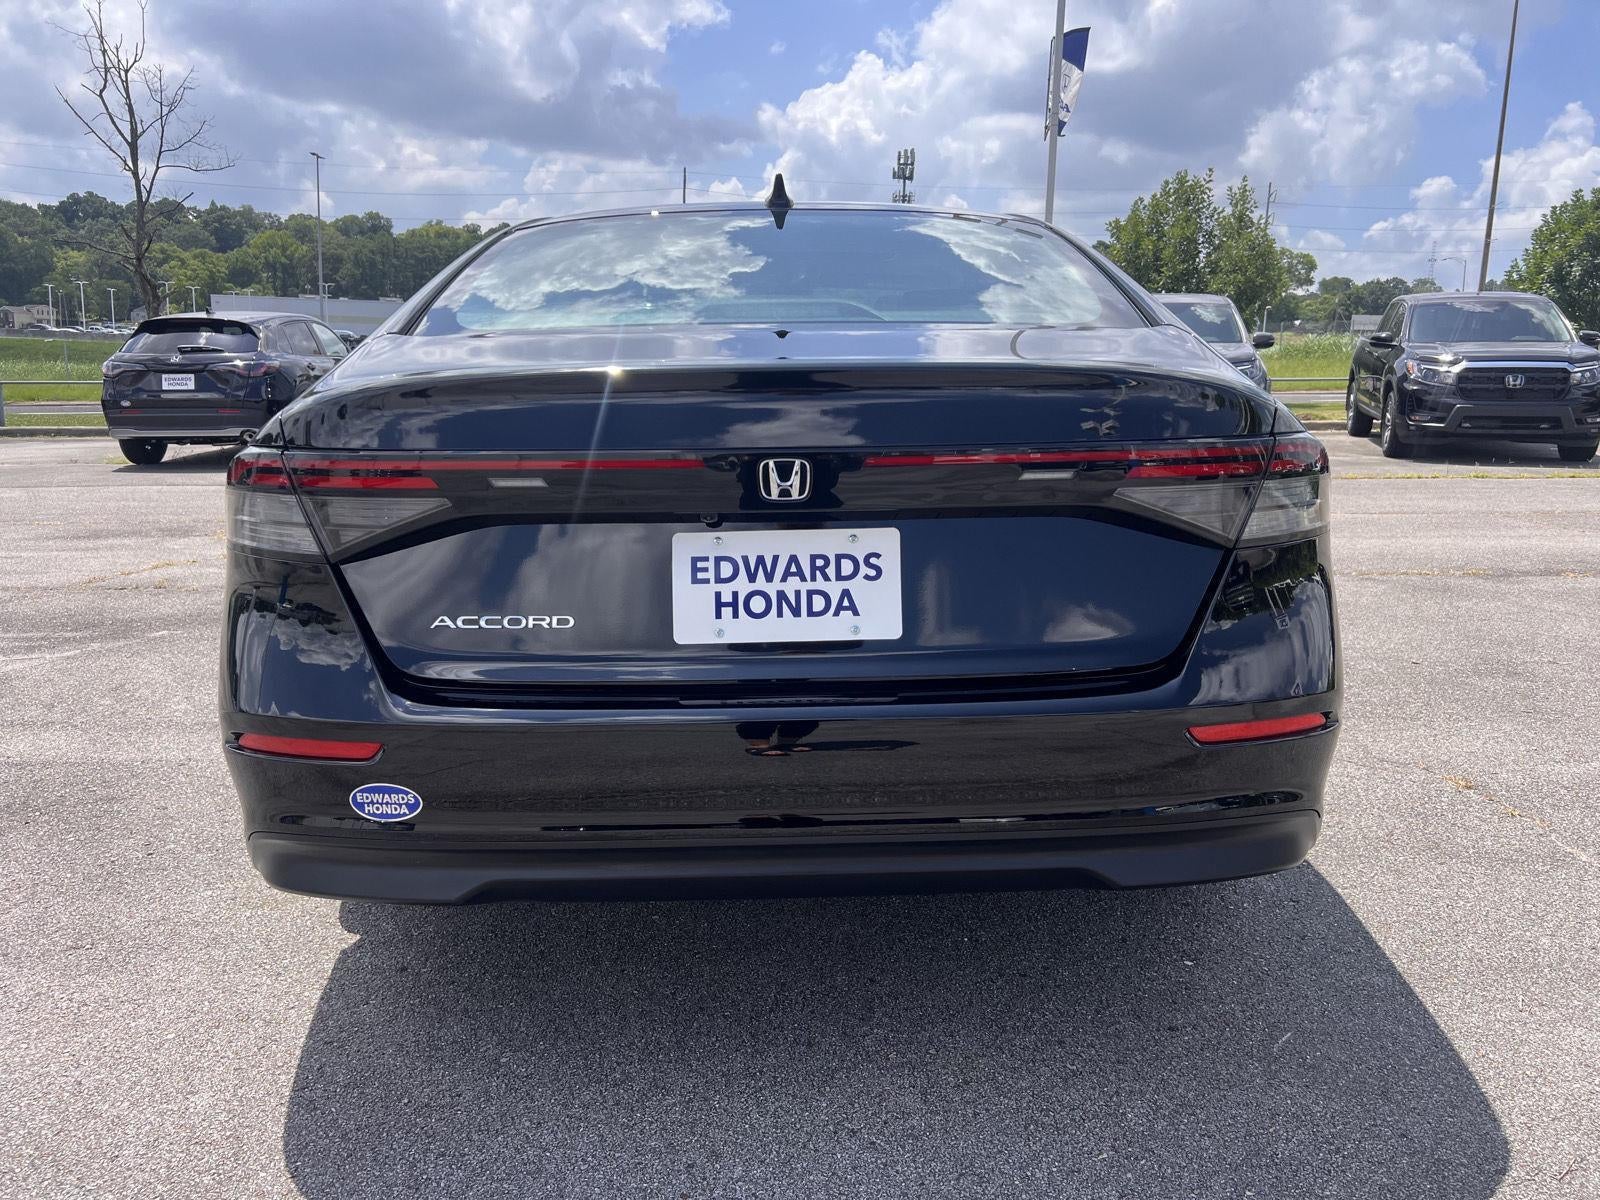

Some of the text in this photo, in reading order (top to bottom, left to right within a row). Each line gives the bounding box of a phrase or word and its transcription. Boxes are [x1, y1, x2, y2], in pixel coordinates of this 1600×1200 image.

[690, 552, 883, 585] EDWARDS
[714, 588, 861, 620] HONDA
[430, 615, 575, 629] ACCORD
[356, 792, 415, 804] EDWARDS
[364, 803, 409, 815] HONDA
